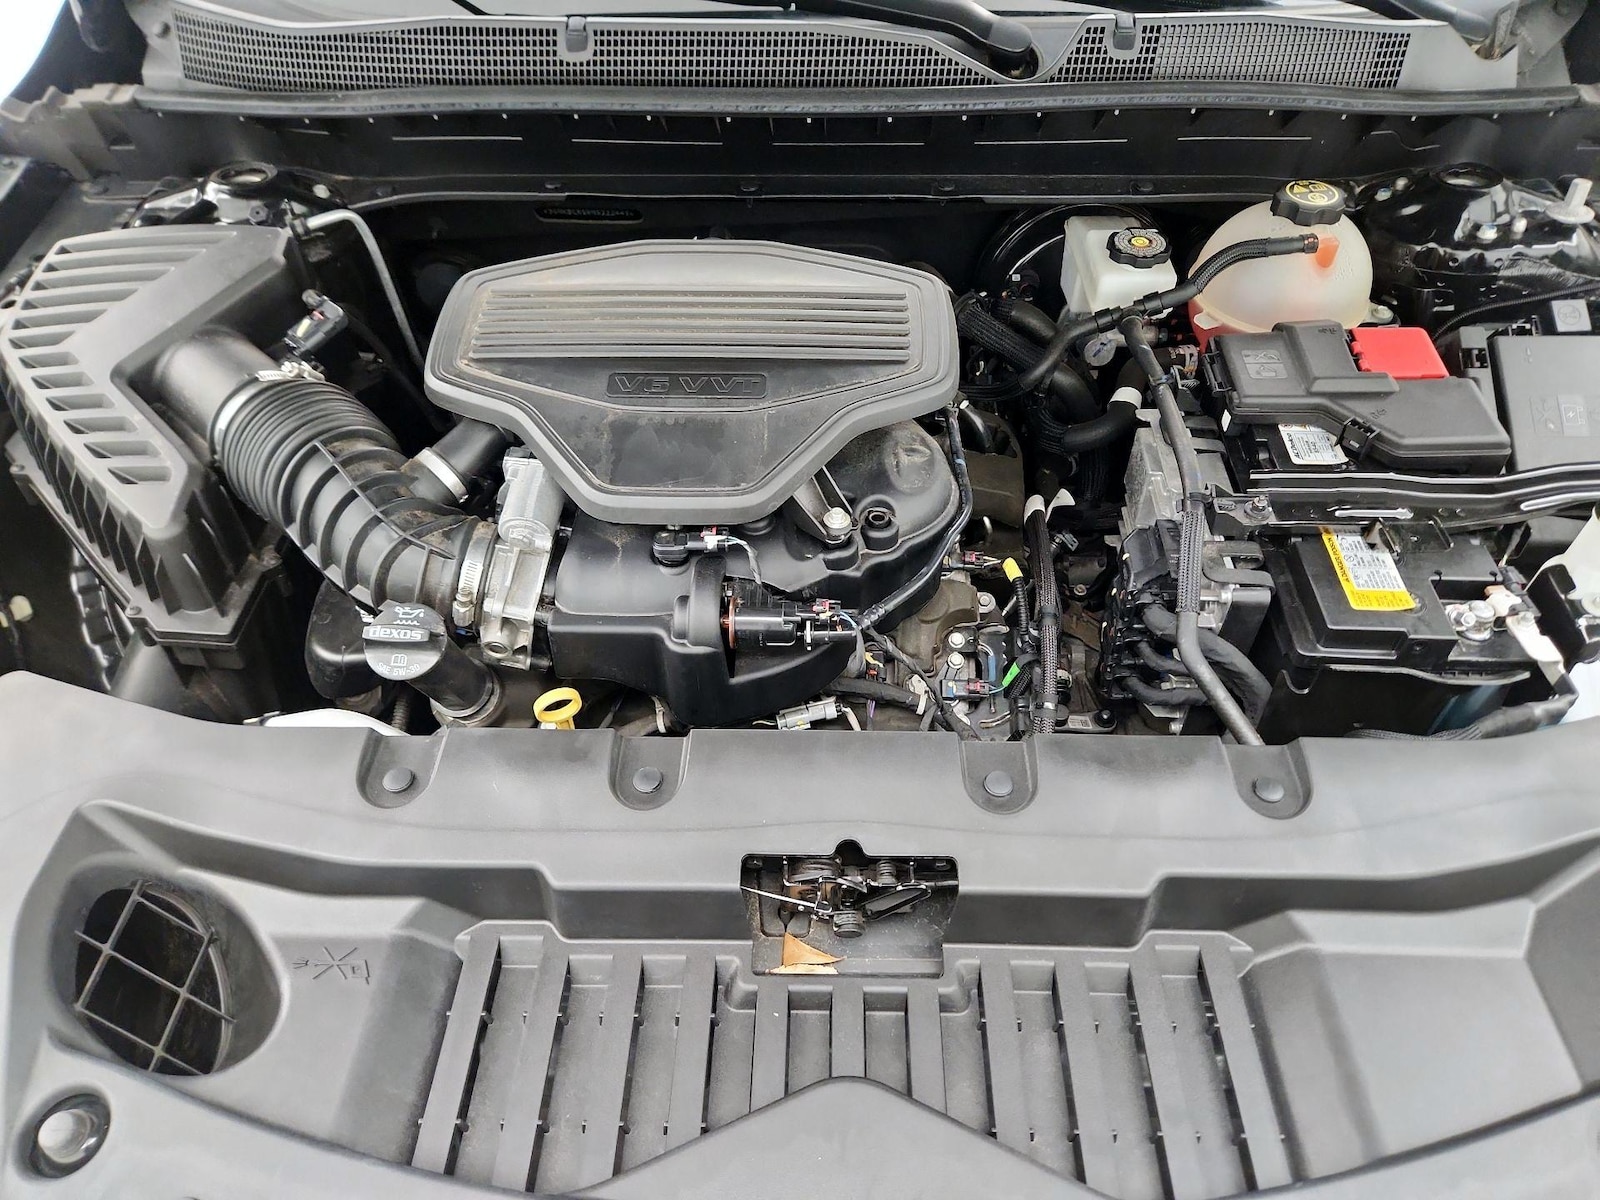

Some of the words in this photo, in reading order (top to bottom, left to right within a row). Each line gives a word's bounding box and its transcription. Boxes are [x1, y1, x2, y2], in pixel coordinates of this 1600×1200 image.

[614, 376, 669, 392] V6
[678, 376, 762, 393] VVT
[368, 625, 423, 640] dexos
[377, 662, 391, 674] SAE
